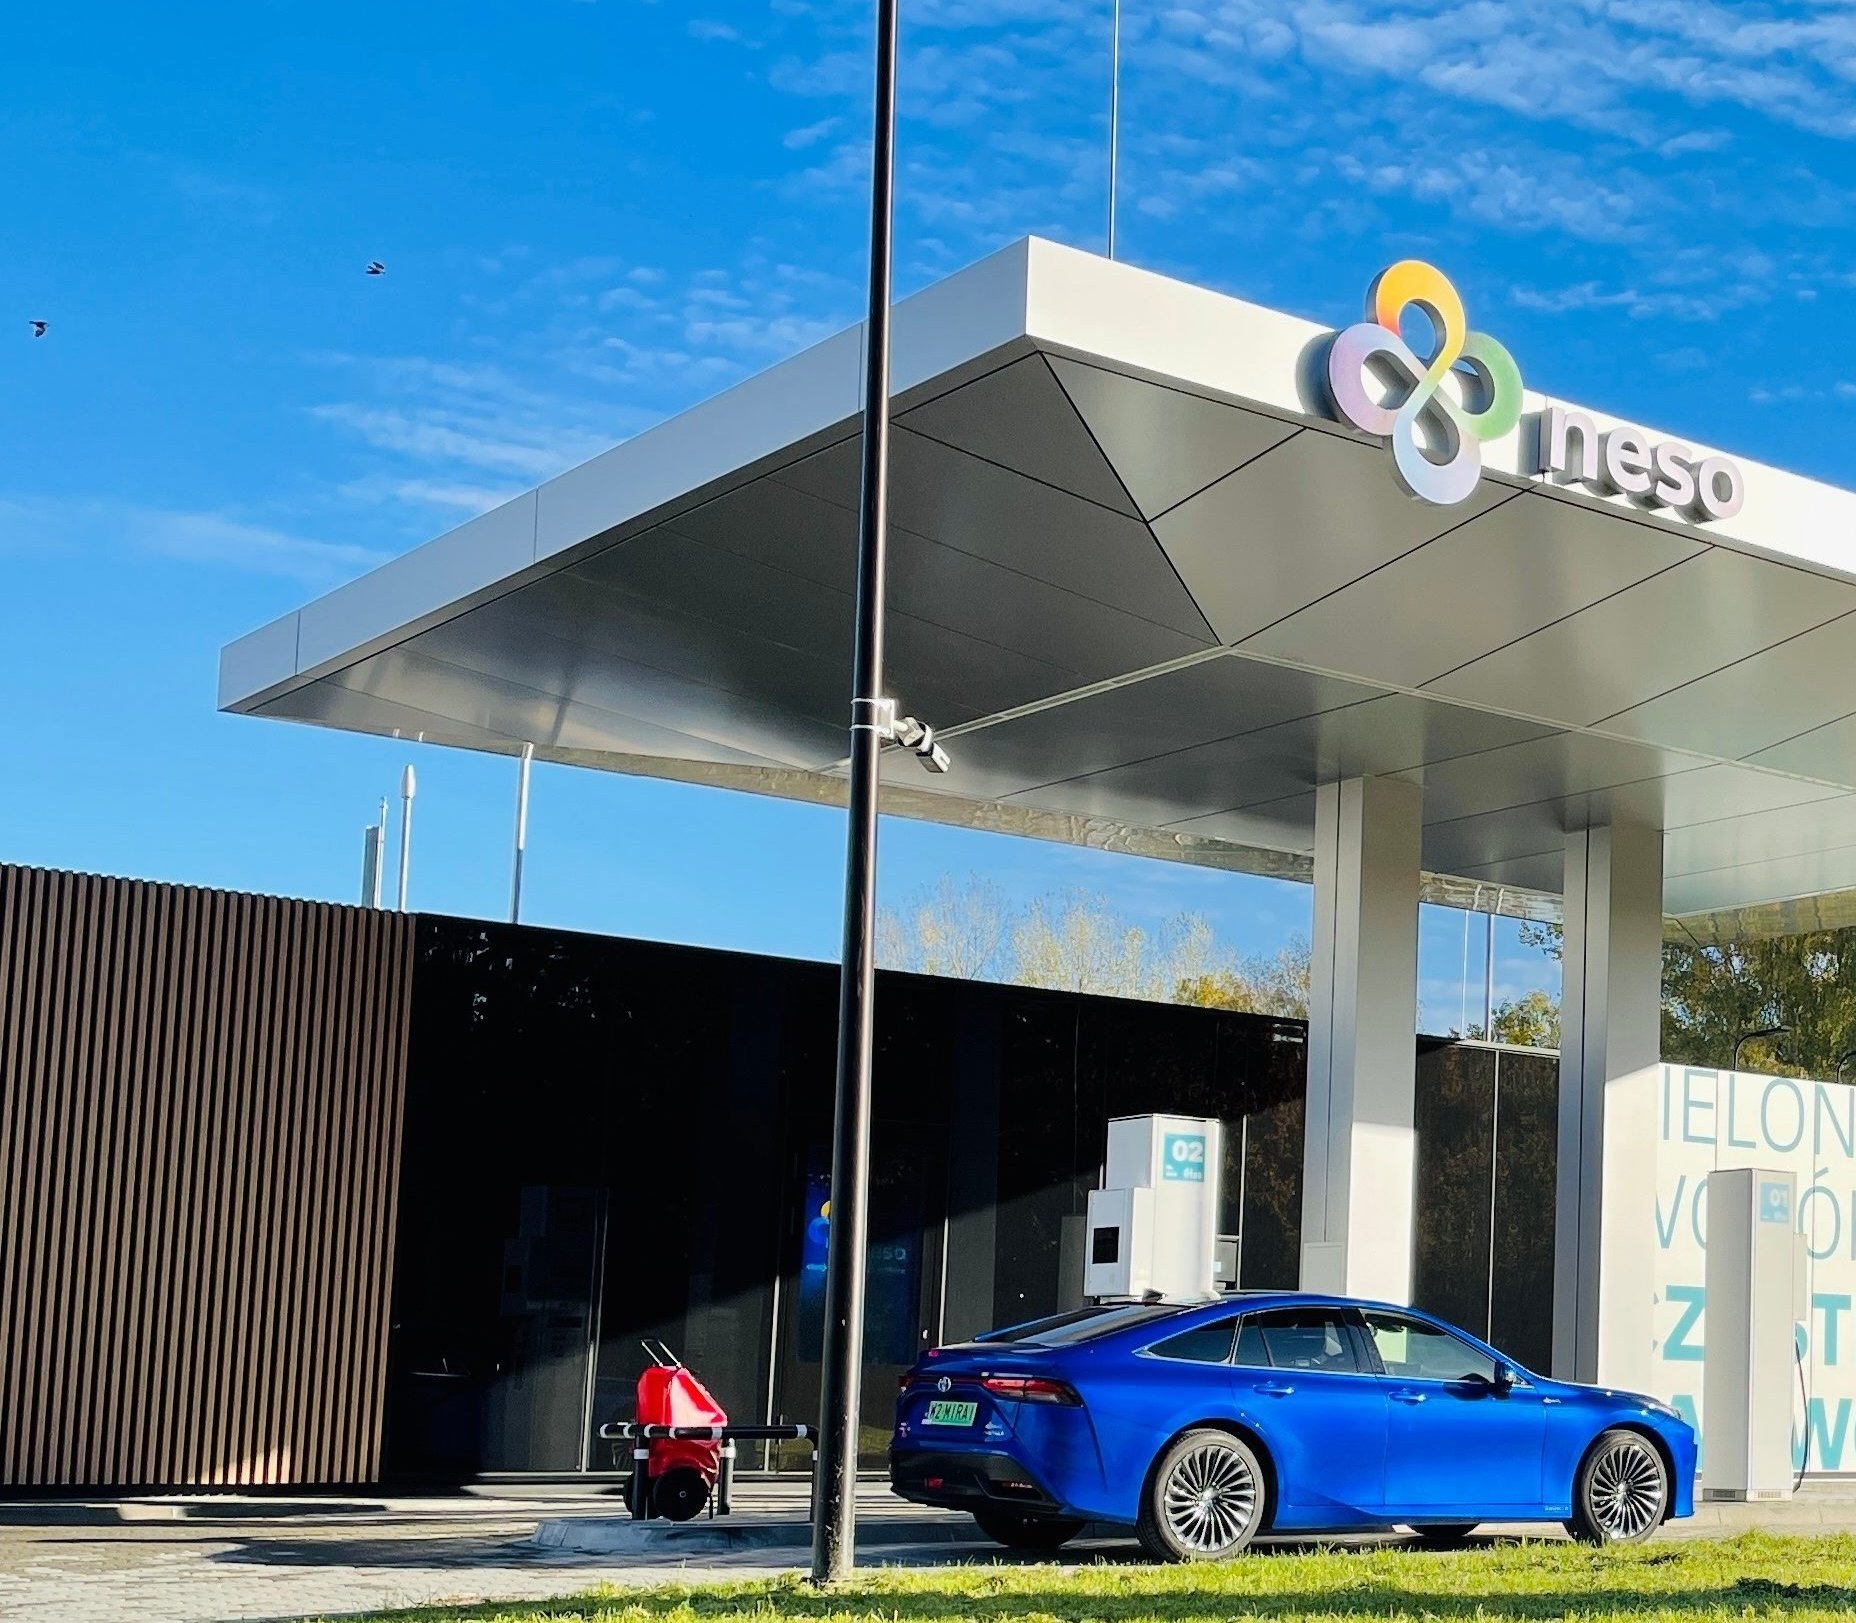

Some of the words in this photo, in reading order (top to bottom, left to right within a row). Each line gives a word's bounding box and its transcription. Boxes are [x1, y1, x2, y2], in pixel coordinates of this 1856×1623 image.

[1546, 407, 1744, 519] neso
[1172, 1139, 1203, 1163] 02
[1769, 1188, 1788, 1207] 01
